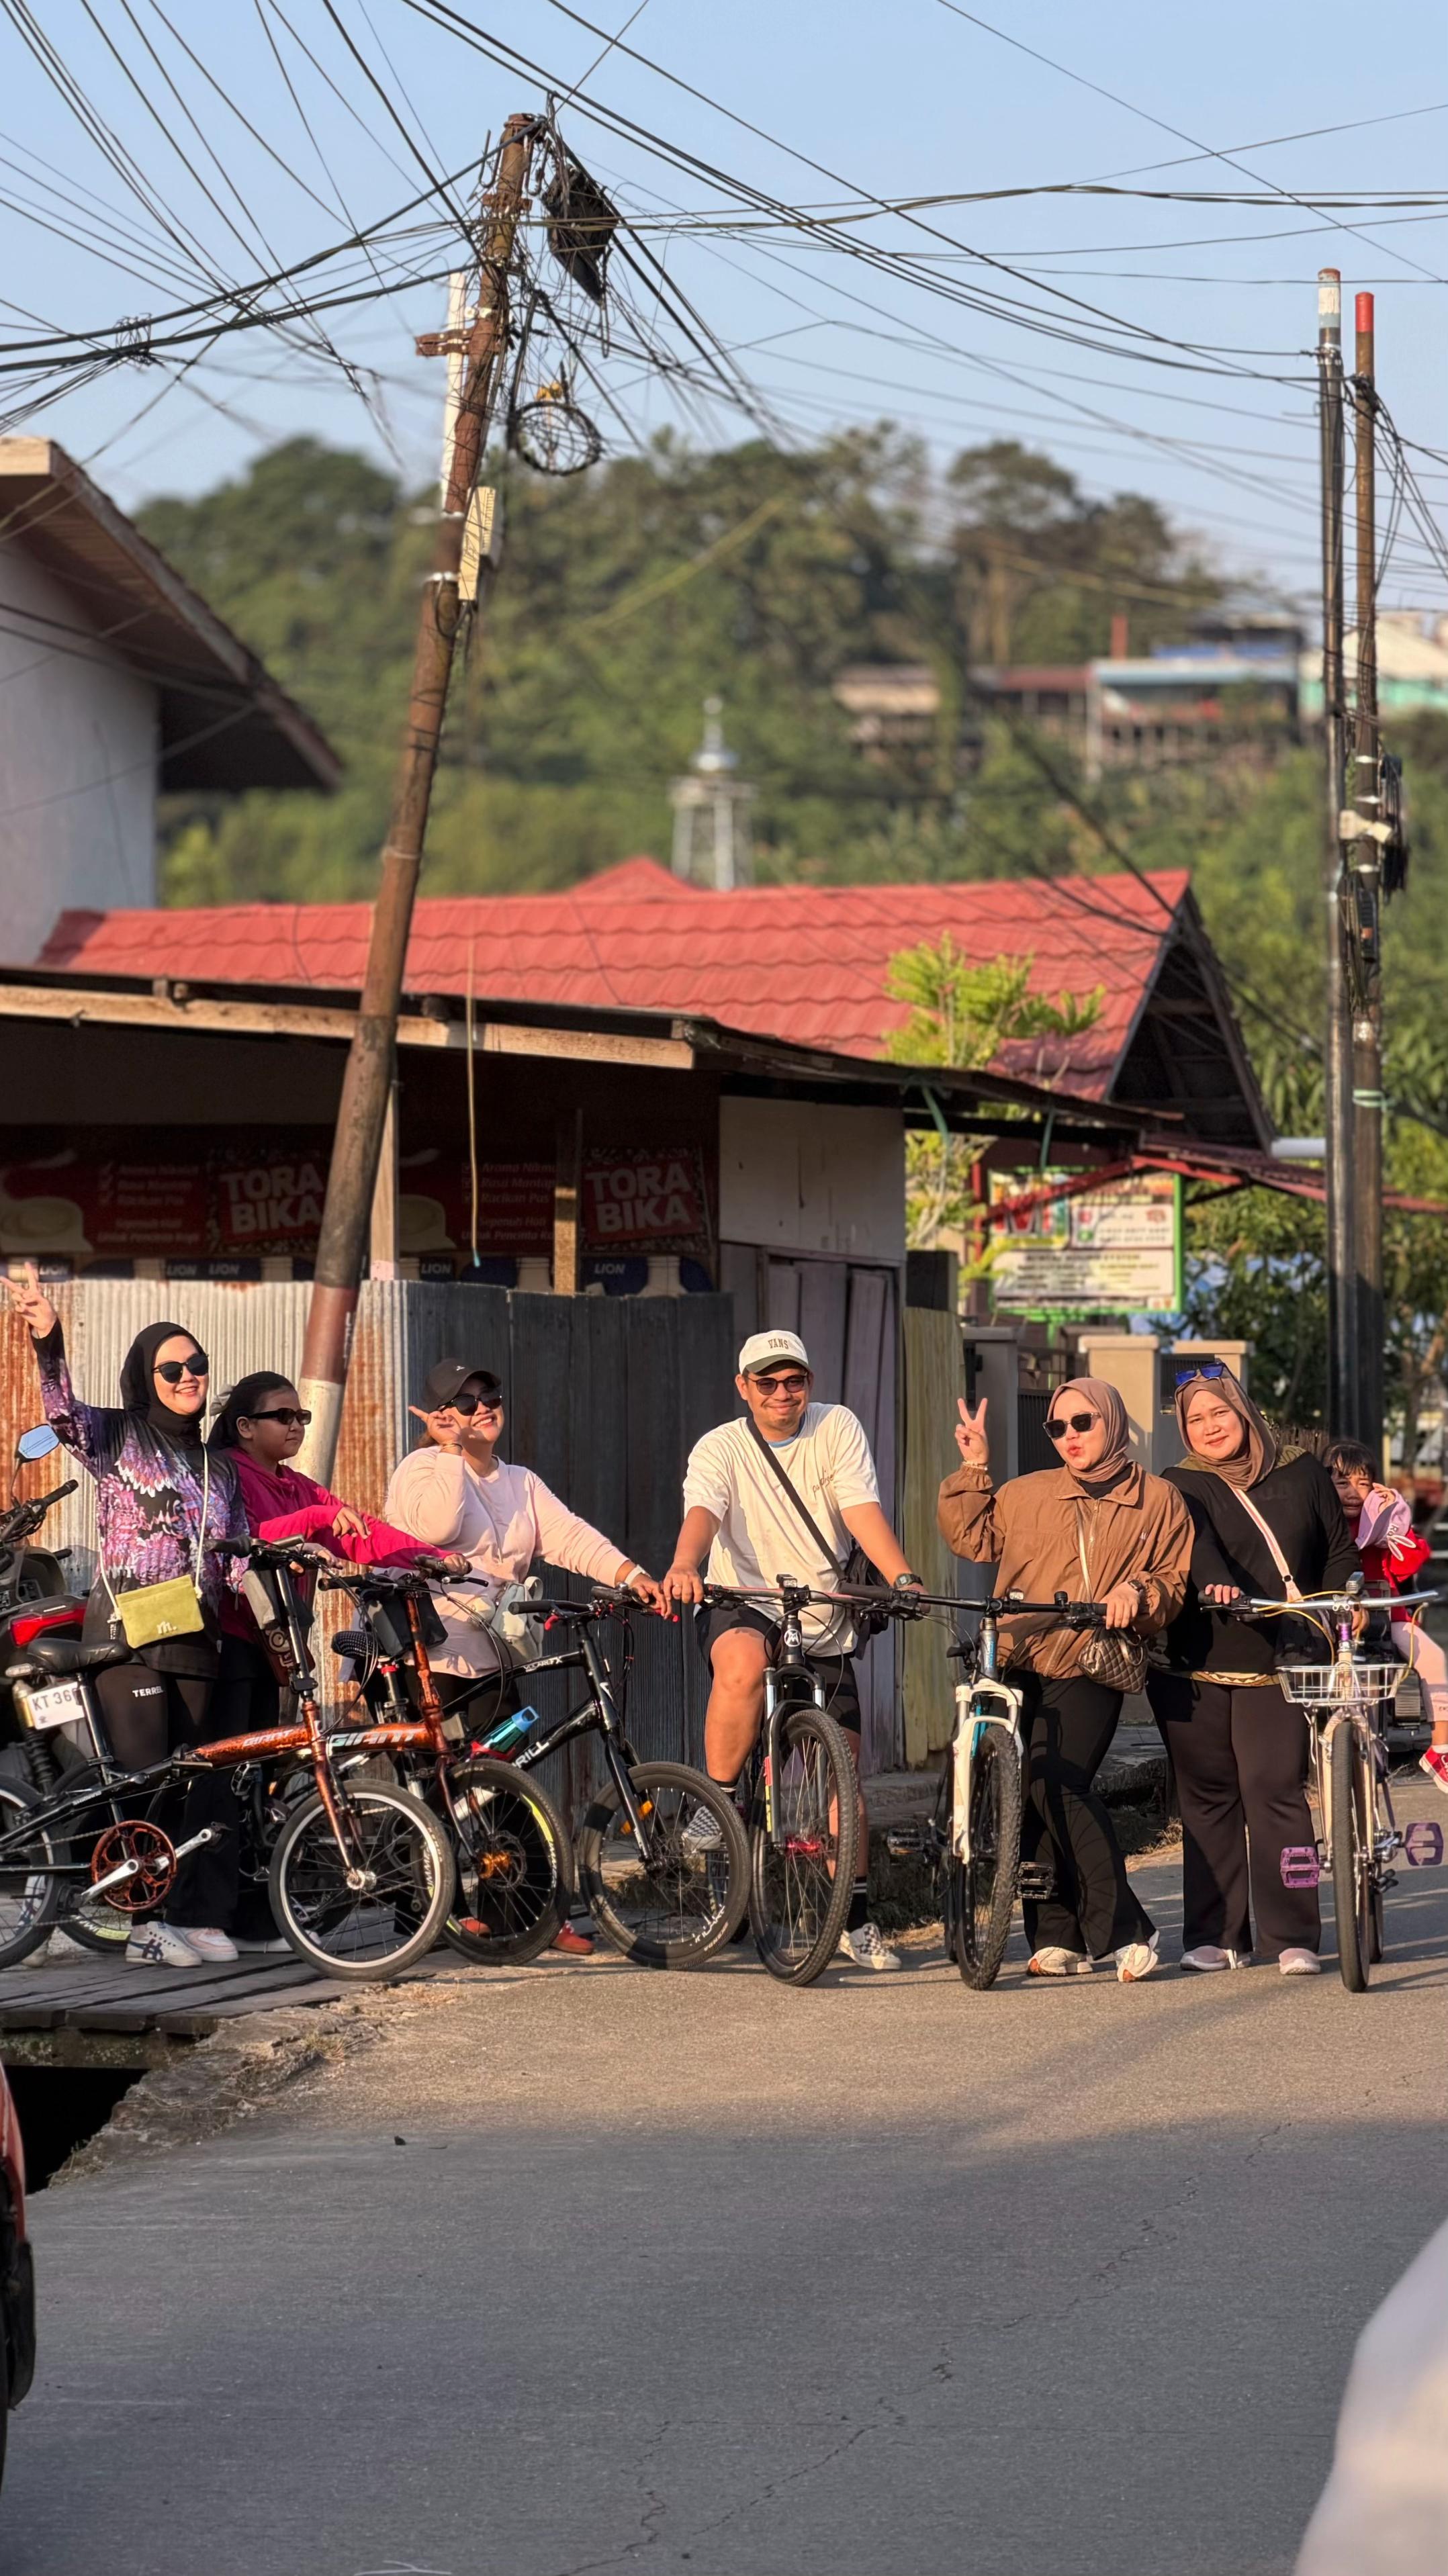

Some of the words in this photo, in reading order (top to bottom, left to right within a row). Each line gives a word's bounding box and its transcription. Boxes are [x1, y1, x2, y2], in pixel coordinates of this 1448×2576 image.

[218, 1162, 324, 1202] TORA
[585, 1162, 691, 1202] TORA
[231, 1195, 323, 1234] BIKA
[596, 1195, 692, 1234] BIKA
[39, 1264, 70, 1276] LION
[167, 1264, 197, 1275] LION
[208, 1264, 240, 1275] LION
[421, 1263, 452, 1275] LION
[594, 1263, 625, 1275] LION
[768, 1338, 789, 1350] VANS
[32, 1695, 49, 1711] KT
[330, 1732, 416, 1747] GIANT
